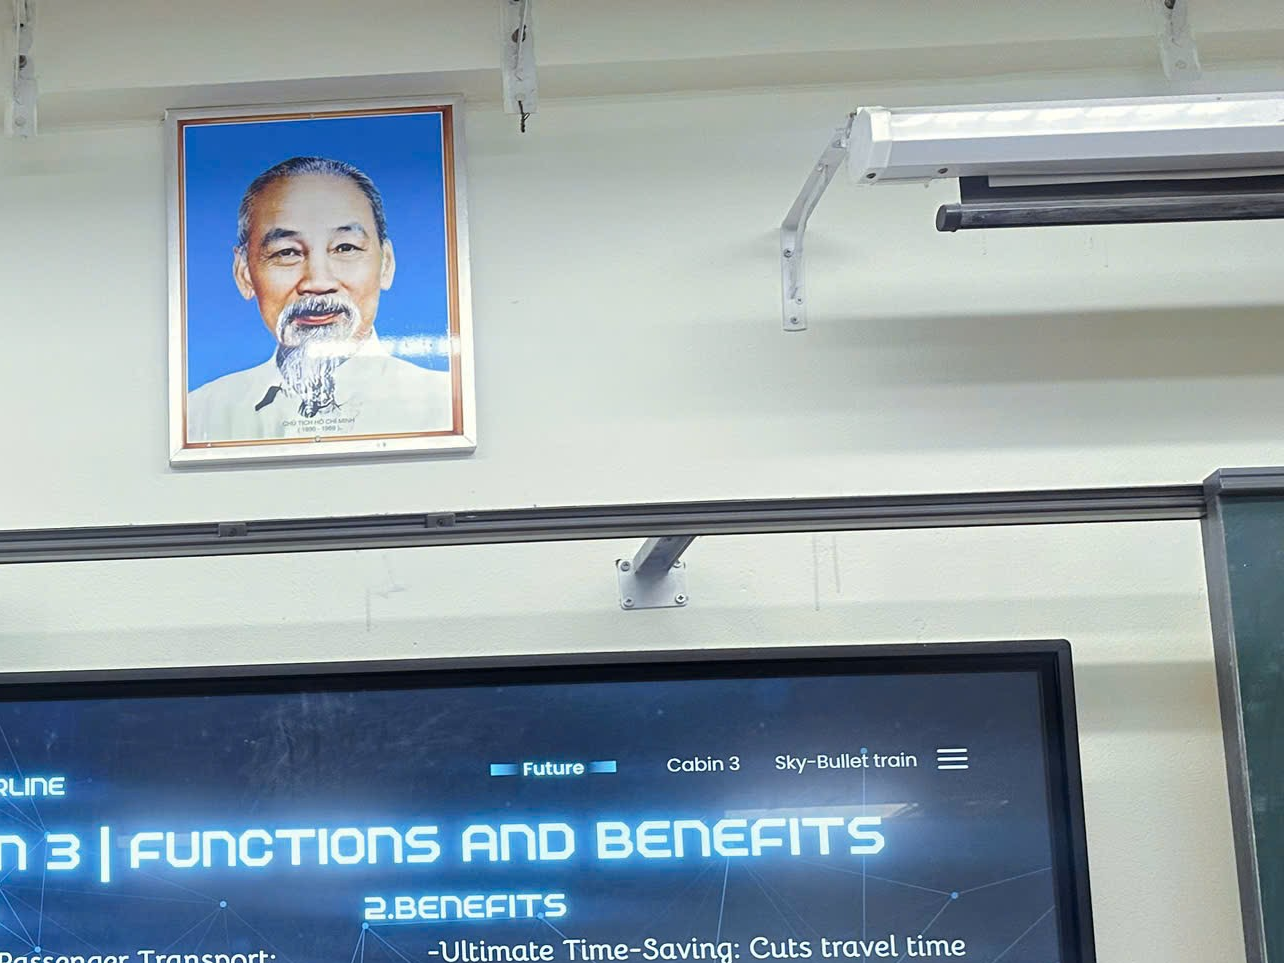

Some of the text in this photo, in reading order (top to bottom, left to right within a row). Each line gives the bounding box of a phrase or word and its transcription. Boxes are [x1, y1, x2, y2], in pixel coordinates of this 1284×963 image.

[523, 760, 584, 777] Future
[667, 755, 741, 773] Cabin 3
[774, 751, 917, 772] Sky-Bullet train
[46, 833, 80, 871] 3
[130, 822, 440, 869] FUNCTIONS
[463, 823, 575, 861] AND
[596, 817, 886, 859] BENEFITS
[364, 894, 566, 919] 2.BENEFITS
[427, 939, 554, 963] -Ultimate
[750, 937, 812, 960] Cuts
[820, 934, 898, 959] travel
[906, 934, 966, 958] time
